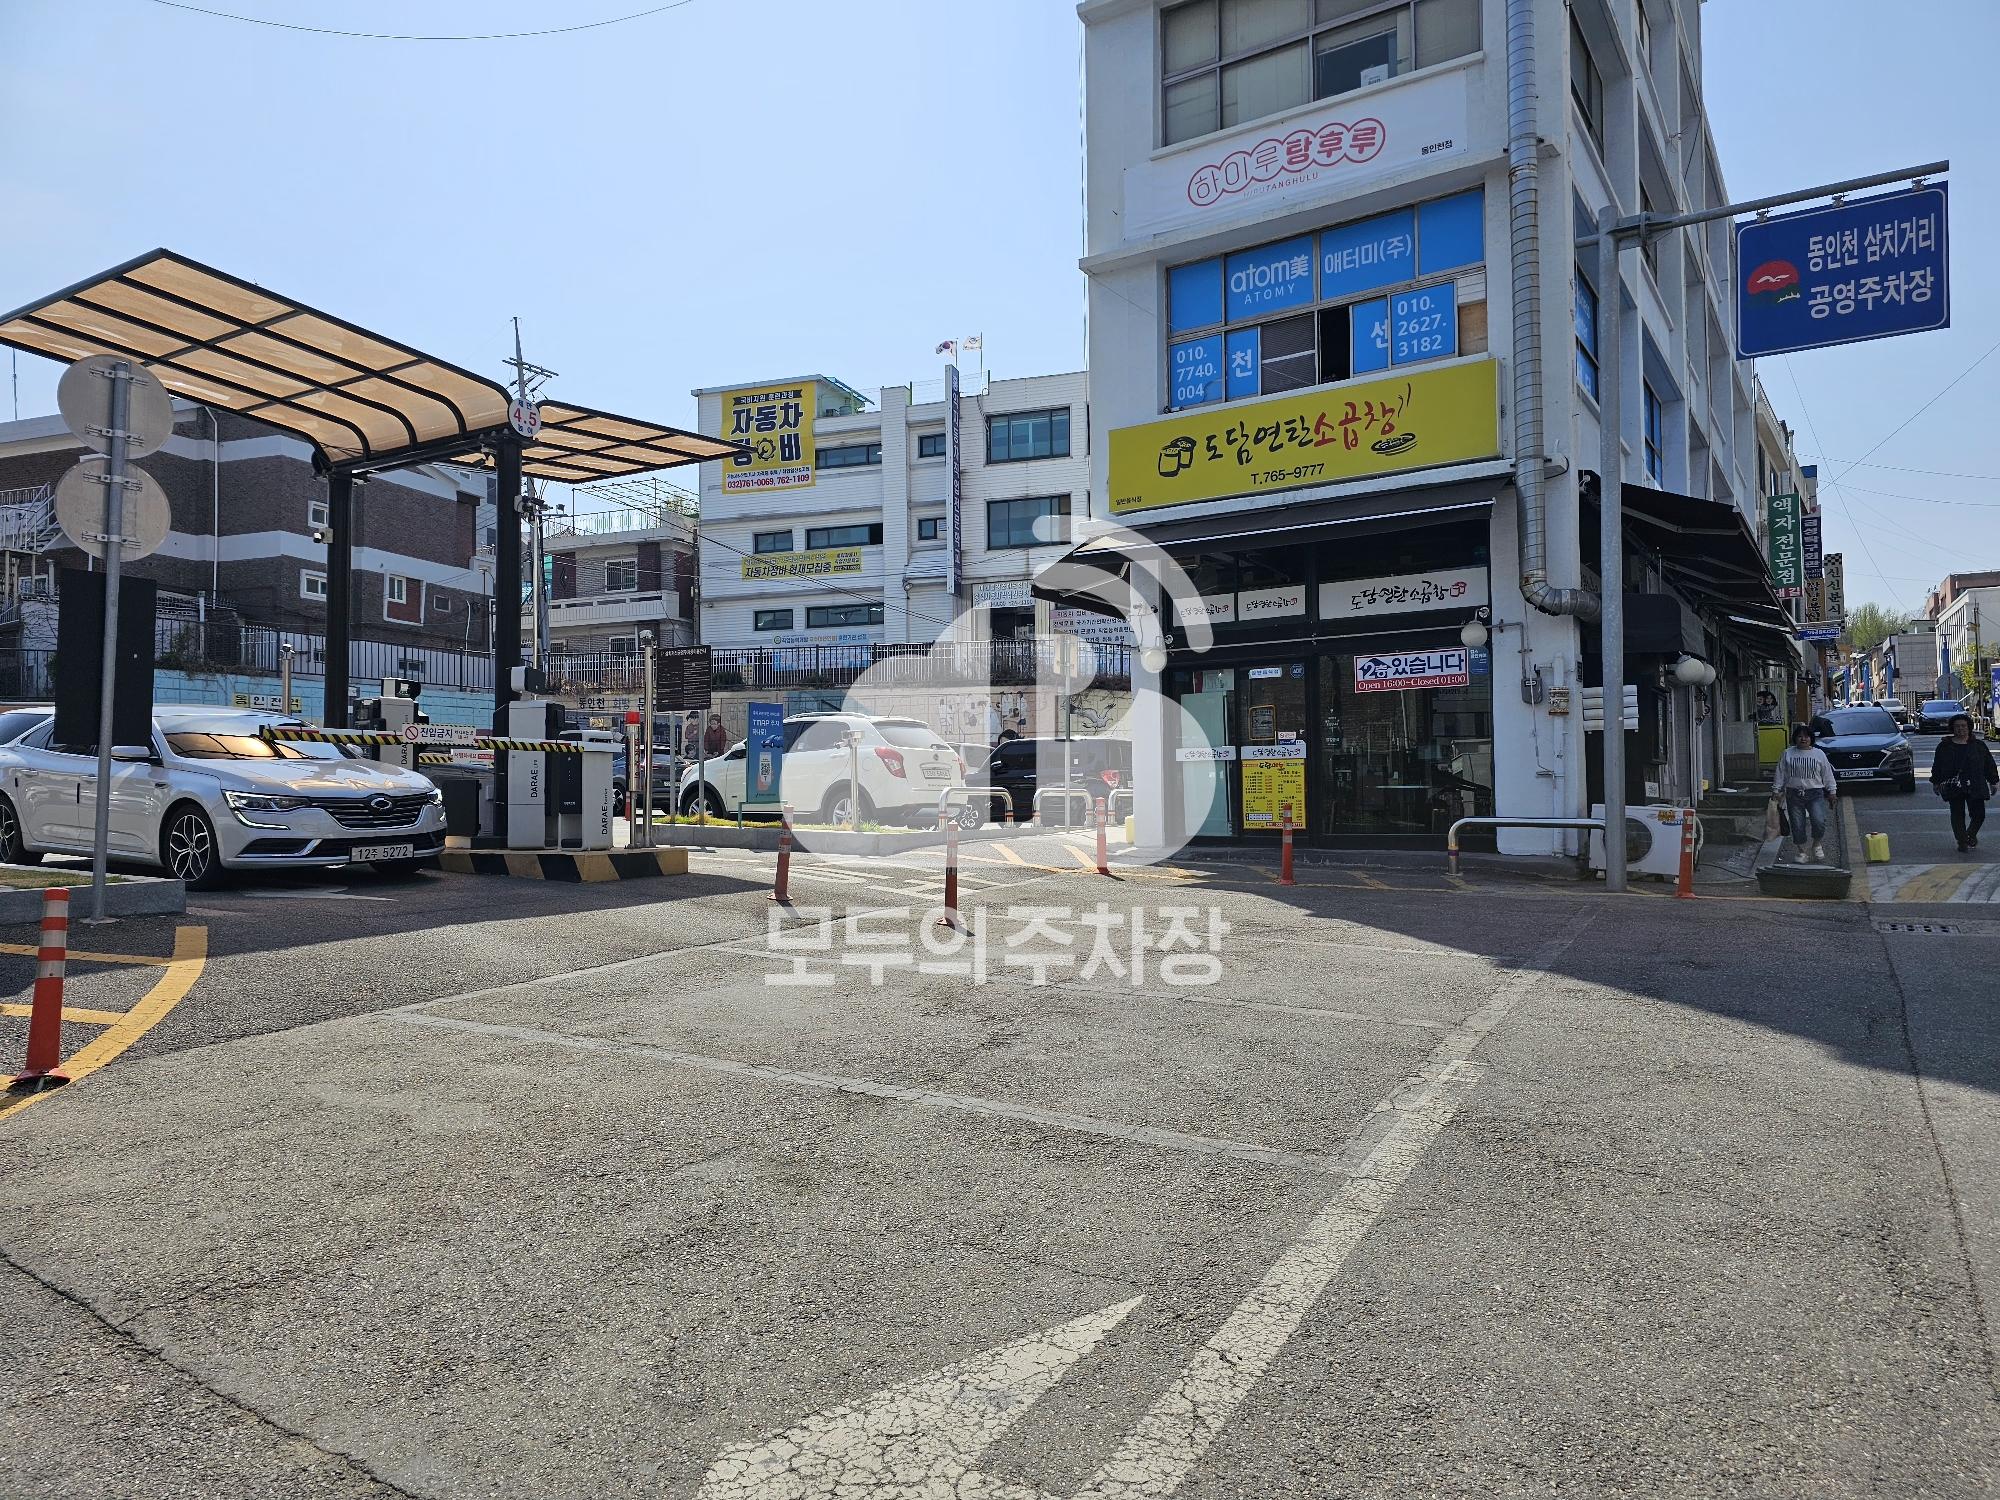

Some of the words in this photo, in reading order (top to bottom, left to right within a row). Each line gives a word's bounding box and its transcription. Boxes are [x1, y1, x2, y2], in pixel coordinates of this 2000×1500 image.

[1421, 139, 1453, 156] 동인천점
[1194, 126, 1377, 199] 하이루탕후루
[1324, 233, 1412, 274] 애터미(주)
[1807, 227, 1858, 272] 동인천
[1864, 212, 1935, 262] 삼치거리
[1244, 283, 1296, 305] ATOMY
[1807, 266, 1935, 319] 공영주차장
[1397, 295, 1435, 316] 010.
[1397, 313, 1447, 337] 2627.
[1176, 346, 1208, 363] 010.
[1398, 335, 1443, 358] 3182
[1176, 362, 1217, 382] 7740.
[1231, 349, 1252, 378] 천
[514, 408, 537, 426] 4.5
[730, 402, 804, 435] 자동차
[1205, 401, 1397, 465] 도담연탄소곱창
[777, 474, 810, 485] 762-1109
[1250, 463, 1325, 486] T.765-9777
[1772, 497, 1797, 585] 액자전문점
[1826, 566, 1841, 615] 신신분식
[1364, 662, 1388, 678] 2층
[1391, 653, 1465, 676] 있습니다
[1358, 681, 1381, 690] Open
[1440, 674, 1466, 685] 01:00
[579, 697, 605, 709] 동인천
[420, 727, 453, 738] 진입금지
[530, 769, 538, 798] DARAE
[358, 848, 378, 860] 12주
[382, 846, 408, 858] 5272
